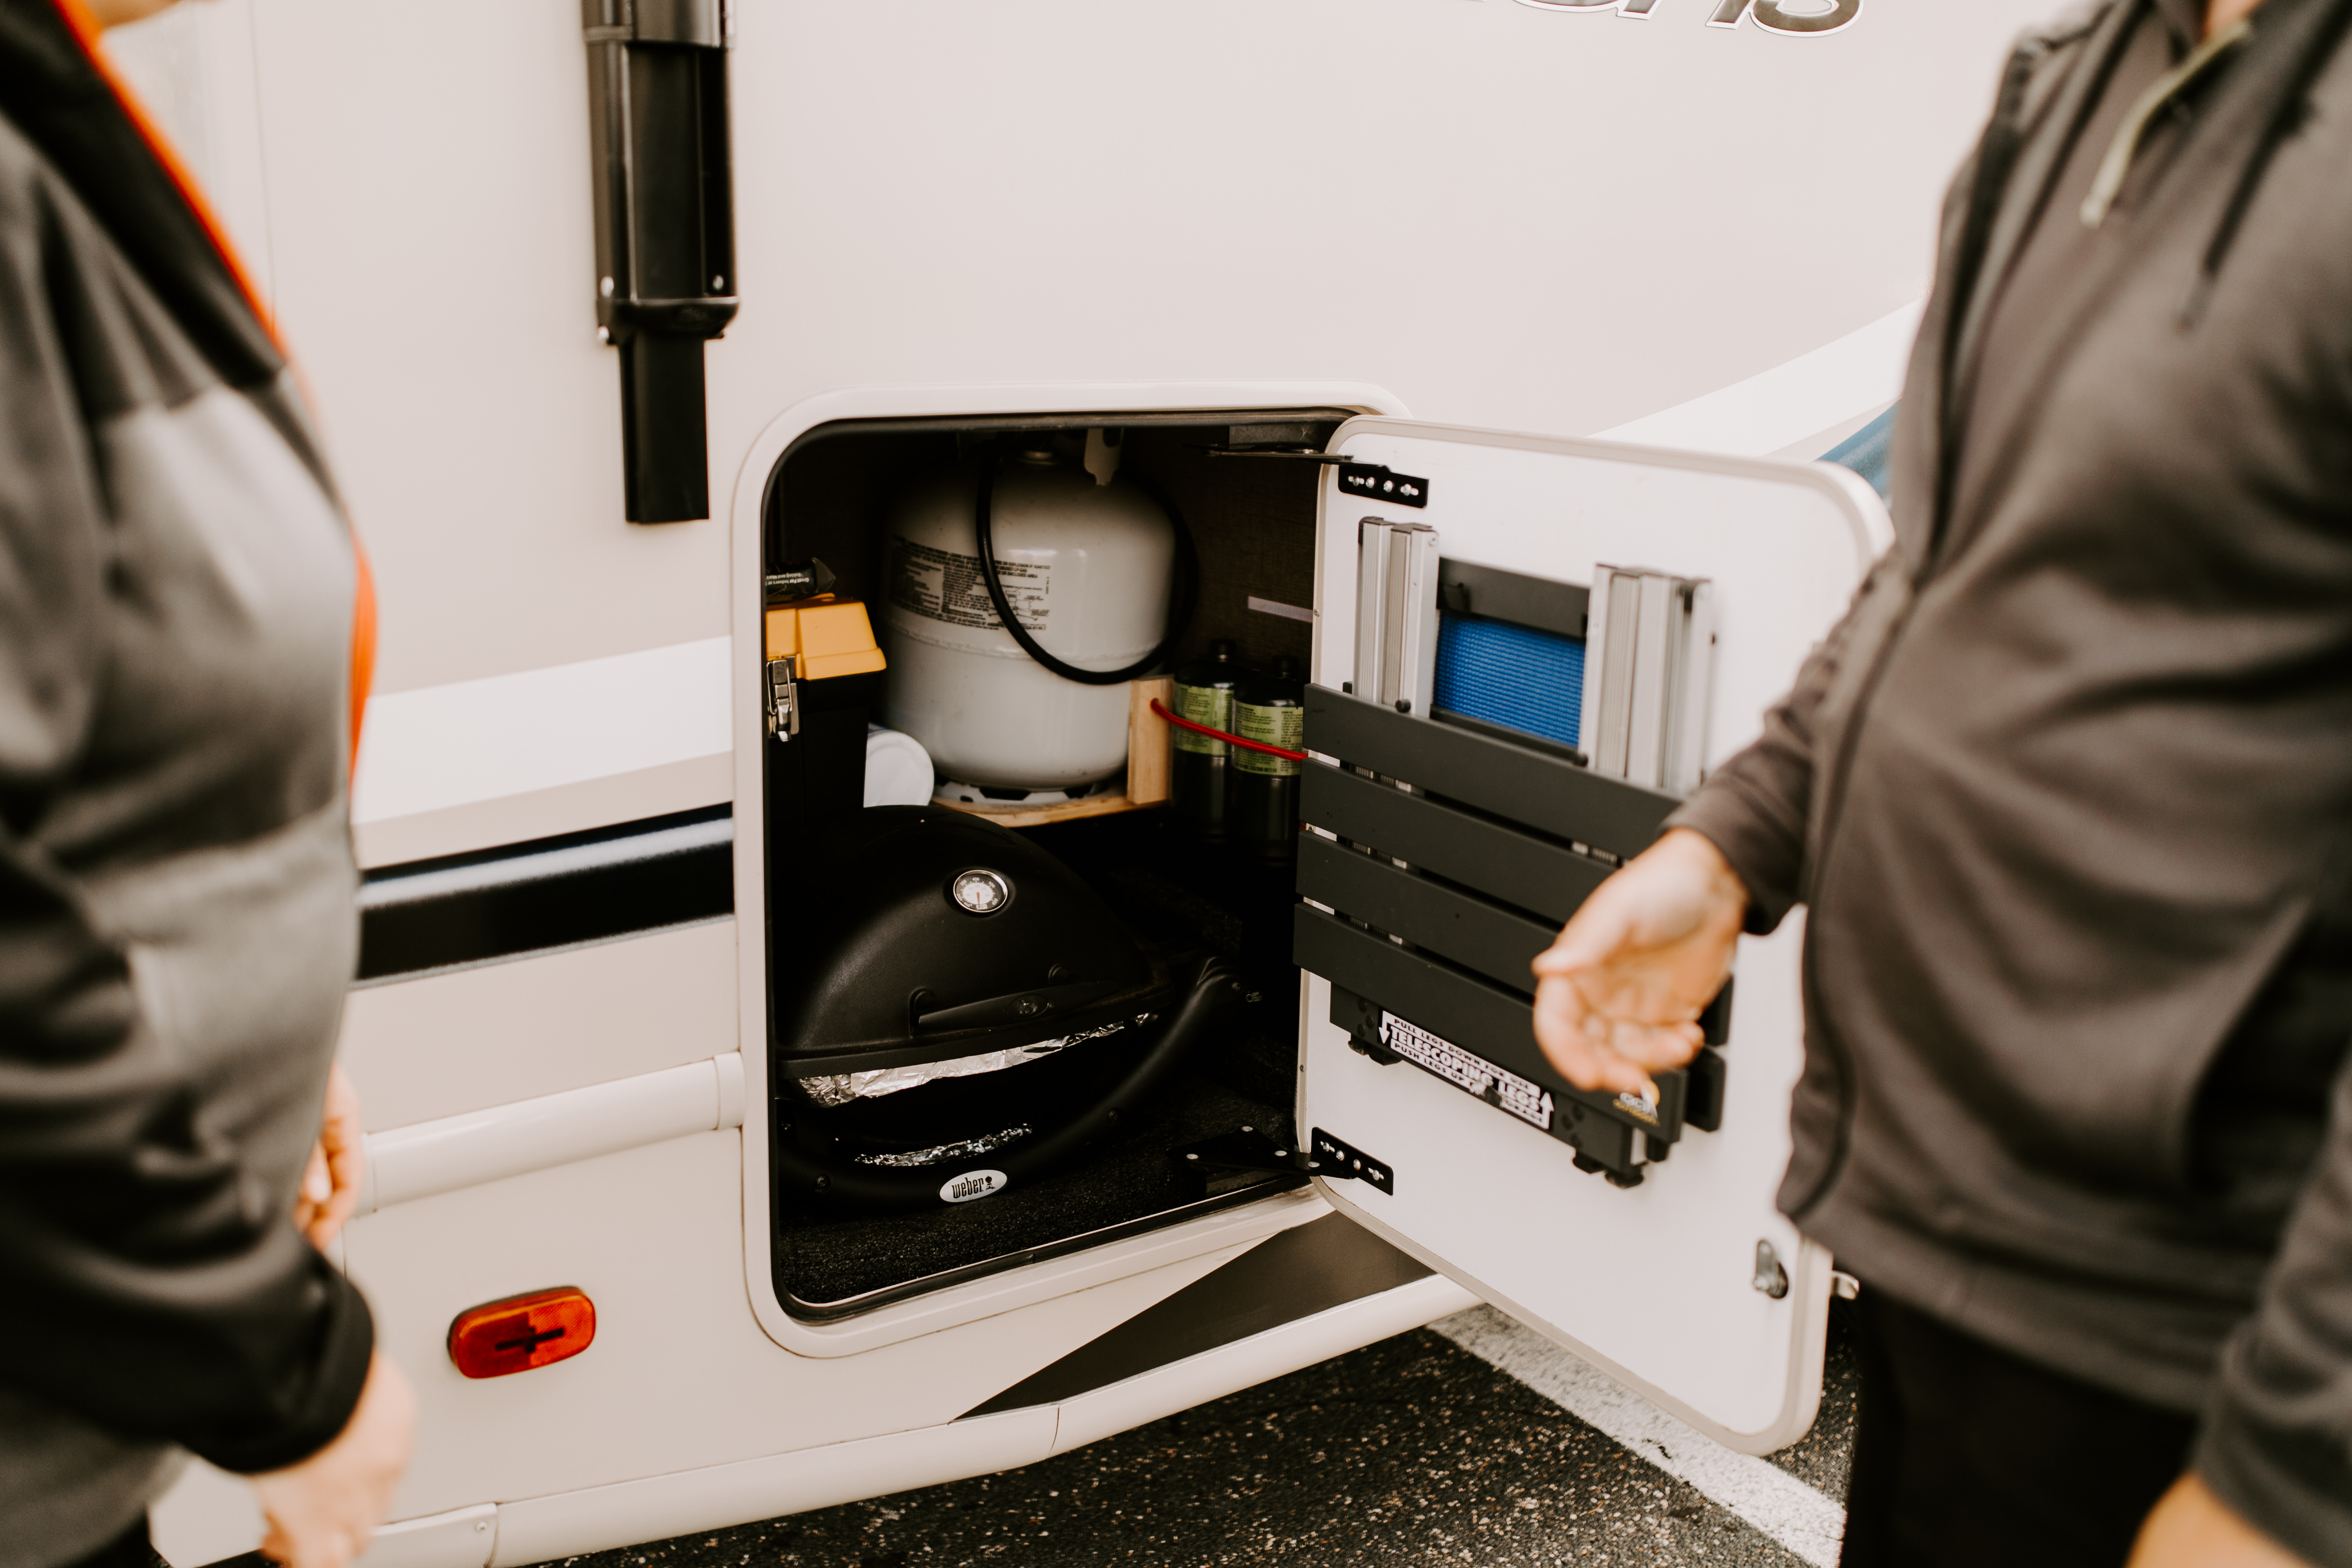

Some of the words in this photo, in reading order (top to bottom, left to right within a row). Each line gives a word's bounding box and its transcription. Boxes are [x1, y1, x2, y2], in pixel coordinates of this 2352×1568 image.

[1390, 1026, 1493, 1086] TELESCOPING
[1498, 1080, 1539, 1111] LEGS
[1394, 1019, 1416, 1034] PULL
[1421, 1032, 1443, 1047] LEGS
[1449, 1046, 1480, 1065] DOWN
[1485, 1064, 1504, 1077] FOR
[1511, 1077, 1528, 1089] USE
[1395, 1043, 1419, 1059] PUSH
[1424, 1058, 1446, 1073] LEGS
[1452, 1072, 1464, 1081] UP
[952, 1177, 984, 1199] weber
